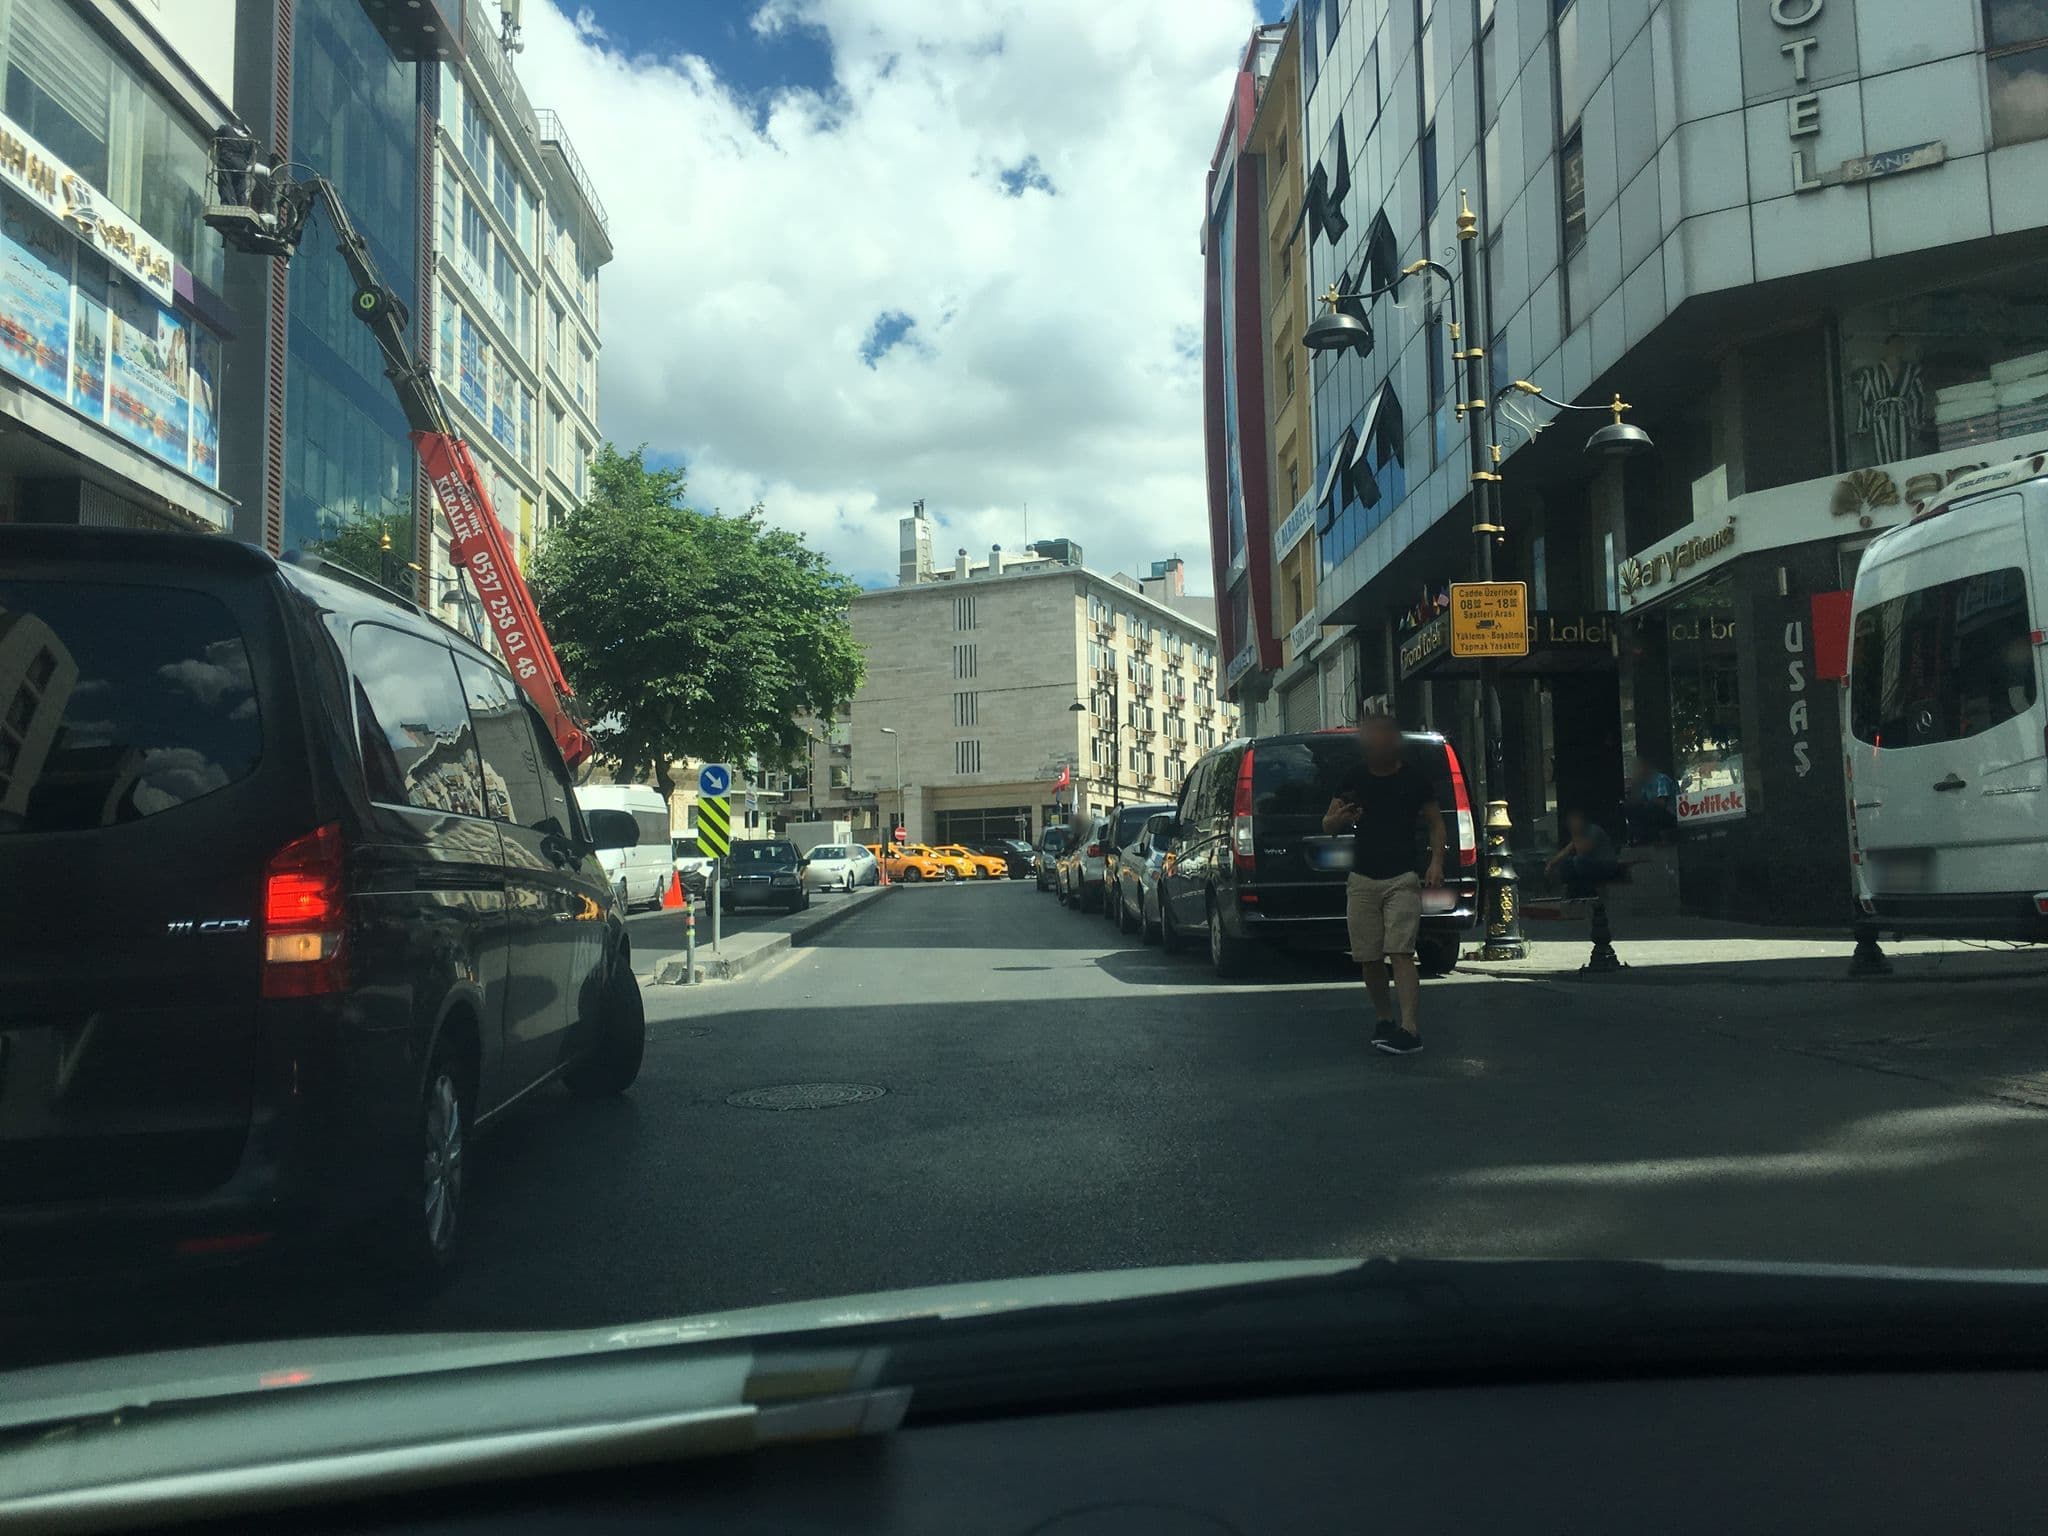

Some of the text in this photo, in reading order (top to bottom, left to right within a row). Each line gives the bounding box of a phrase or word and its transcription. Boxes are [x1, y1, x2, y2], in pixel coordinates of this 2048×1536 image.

[472, 552, 537, 679] 0537 258 61 48
[1784, 621, 1812, 778] USAŞ
[1678, 791, 1745, 818] Özdilek
